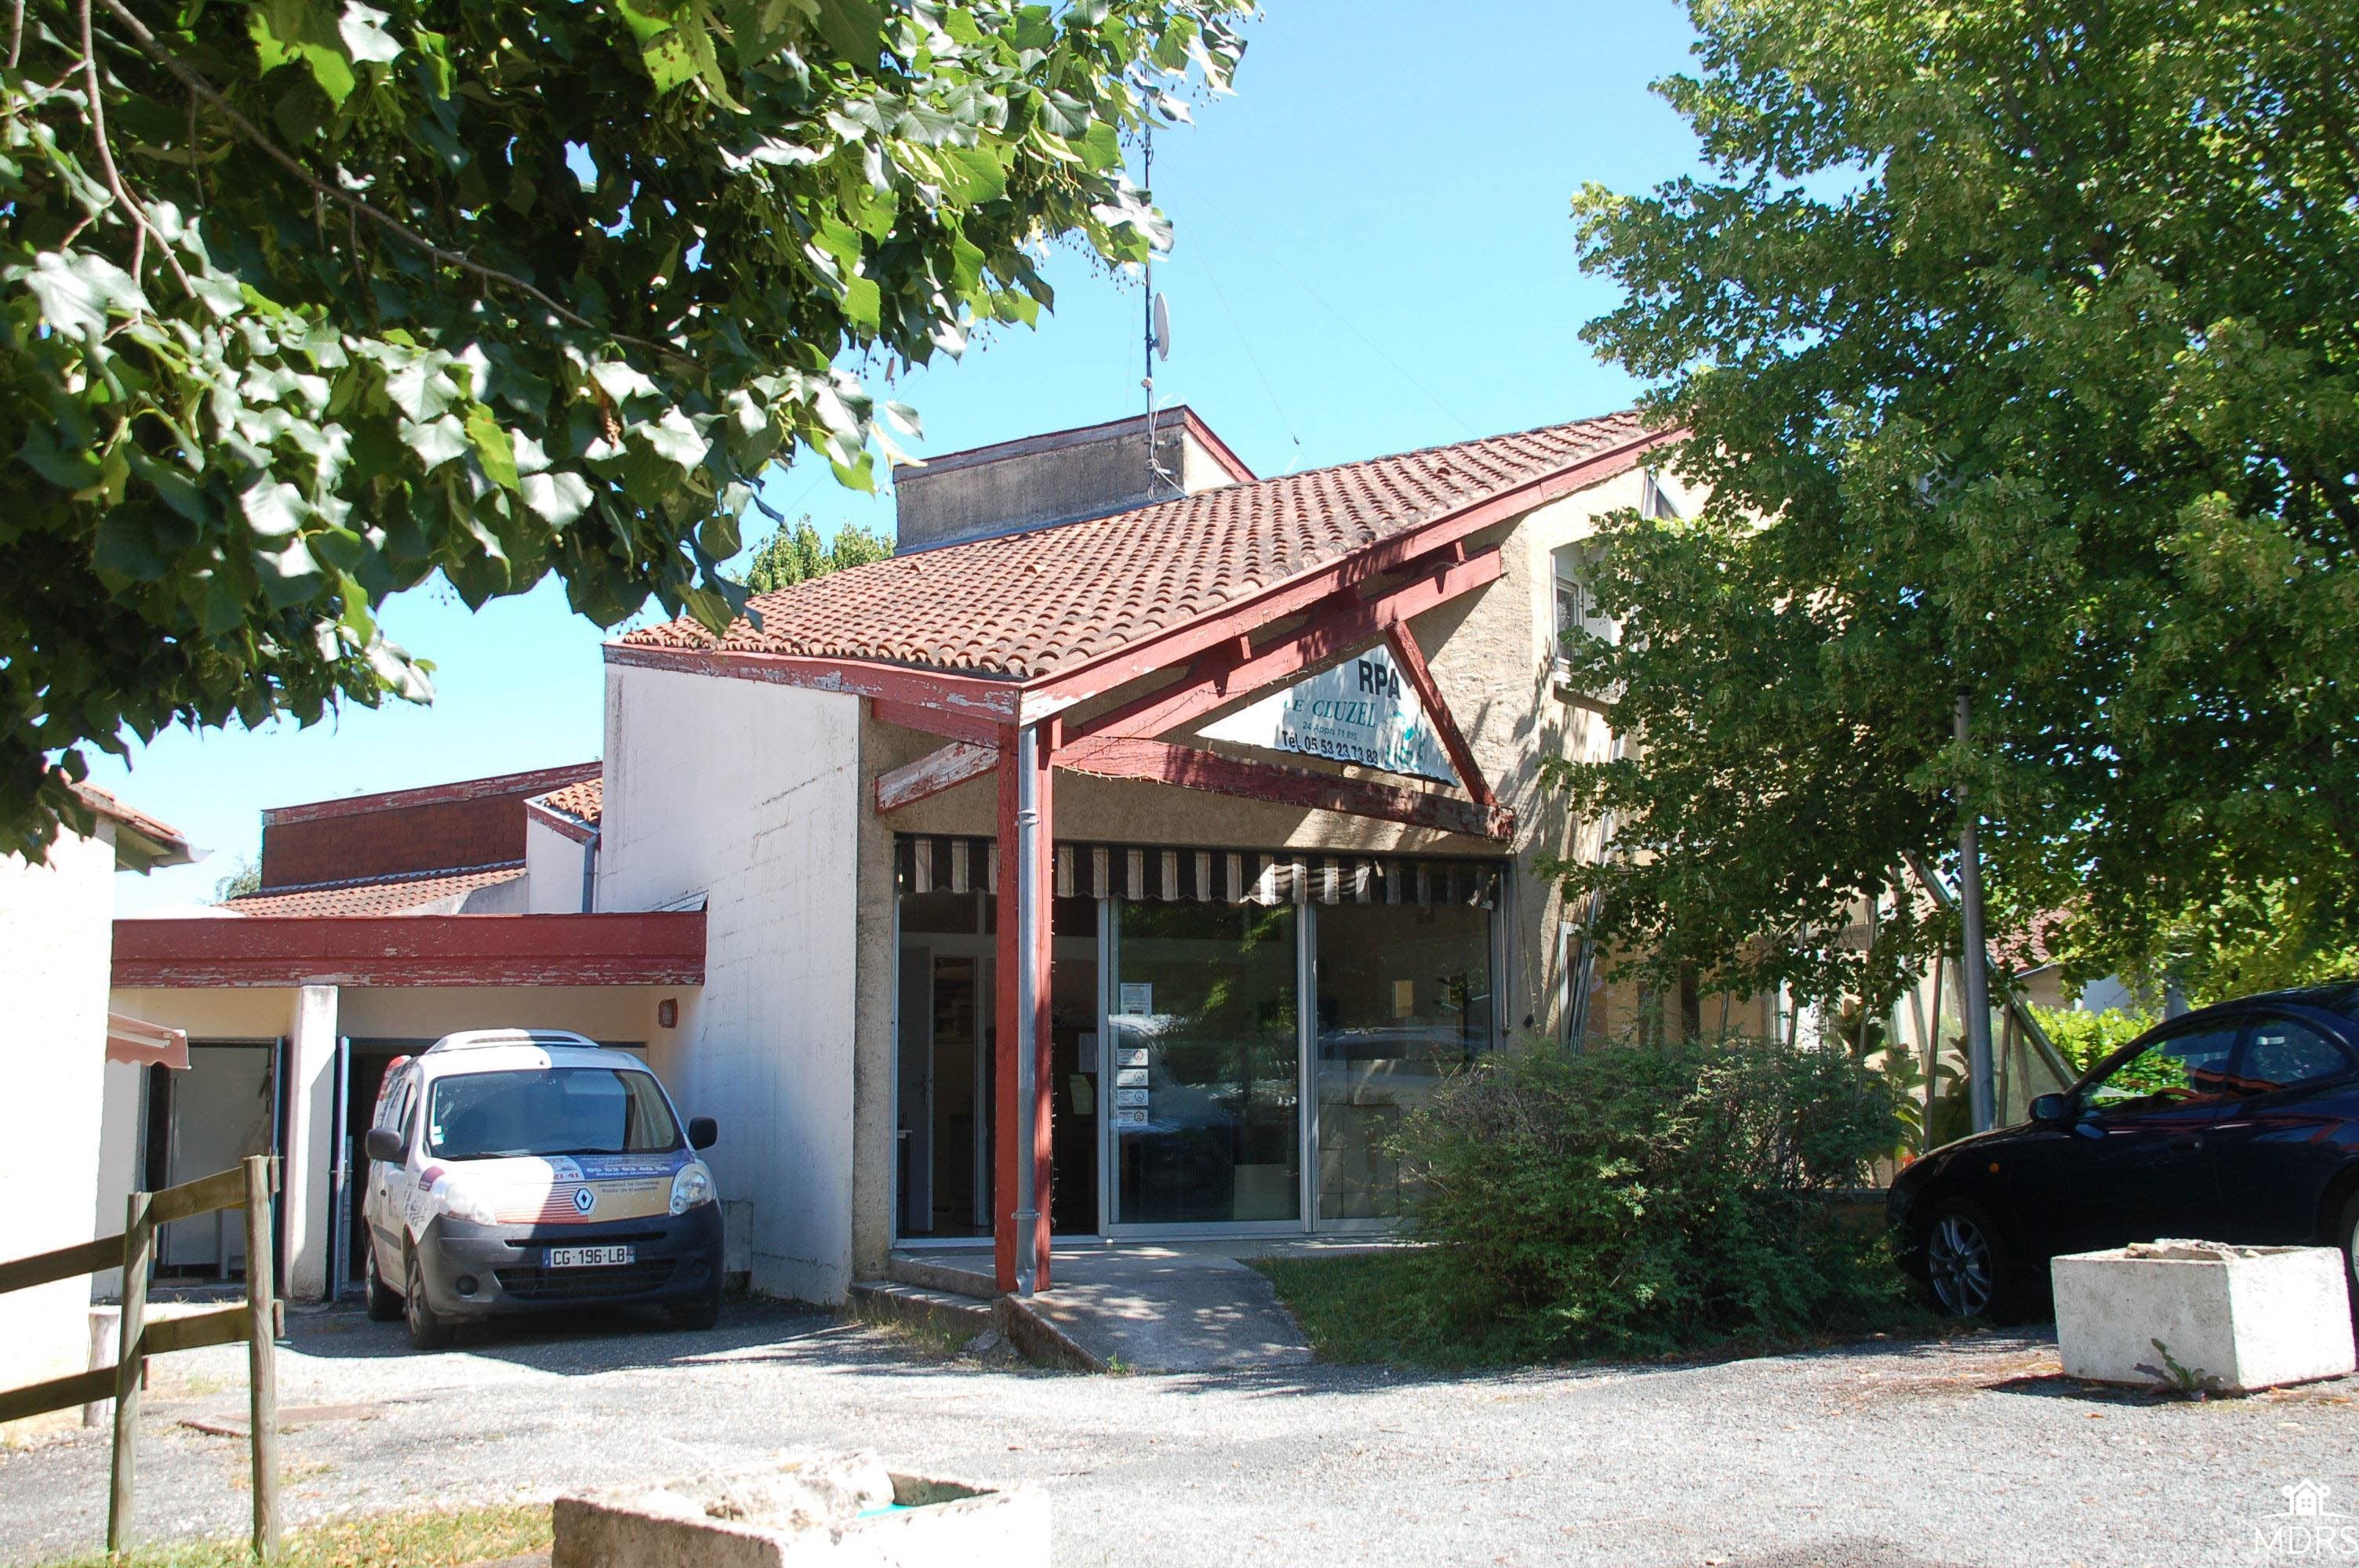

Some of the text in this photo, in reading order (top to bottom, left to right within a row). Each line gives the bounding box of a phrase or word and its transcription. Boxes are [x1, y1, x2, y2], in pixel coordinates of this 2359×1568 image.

[1358, 659, 1401, 700] RPA
[1303, 720, 1312, 731] 24
[1312, 699, 1376, 728] CLUZEL
[1304, 735, 1318, 751] 05
[1321, 739, 1334, 755] 53
[1336, 742, 1350, 759] 23
[1351, 745, 1365, 763] 73
[553, 1247, 625, 1265] CG-196-LB
